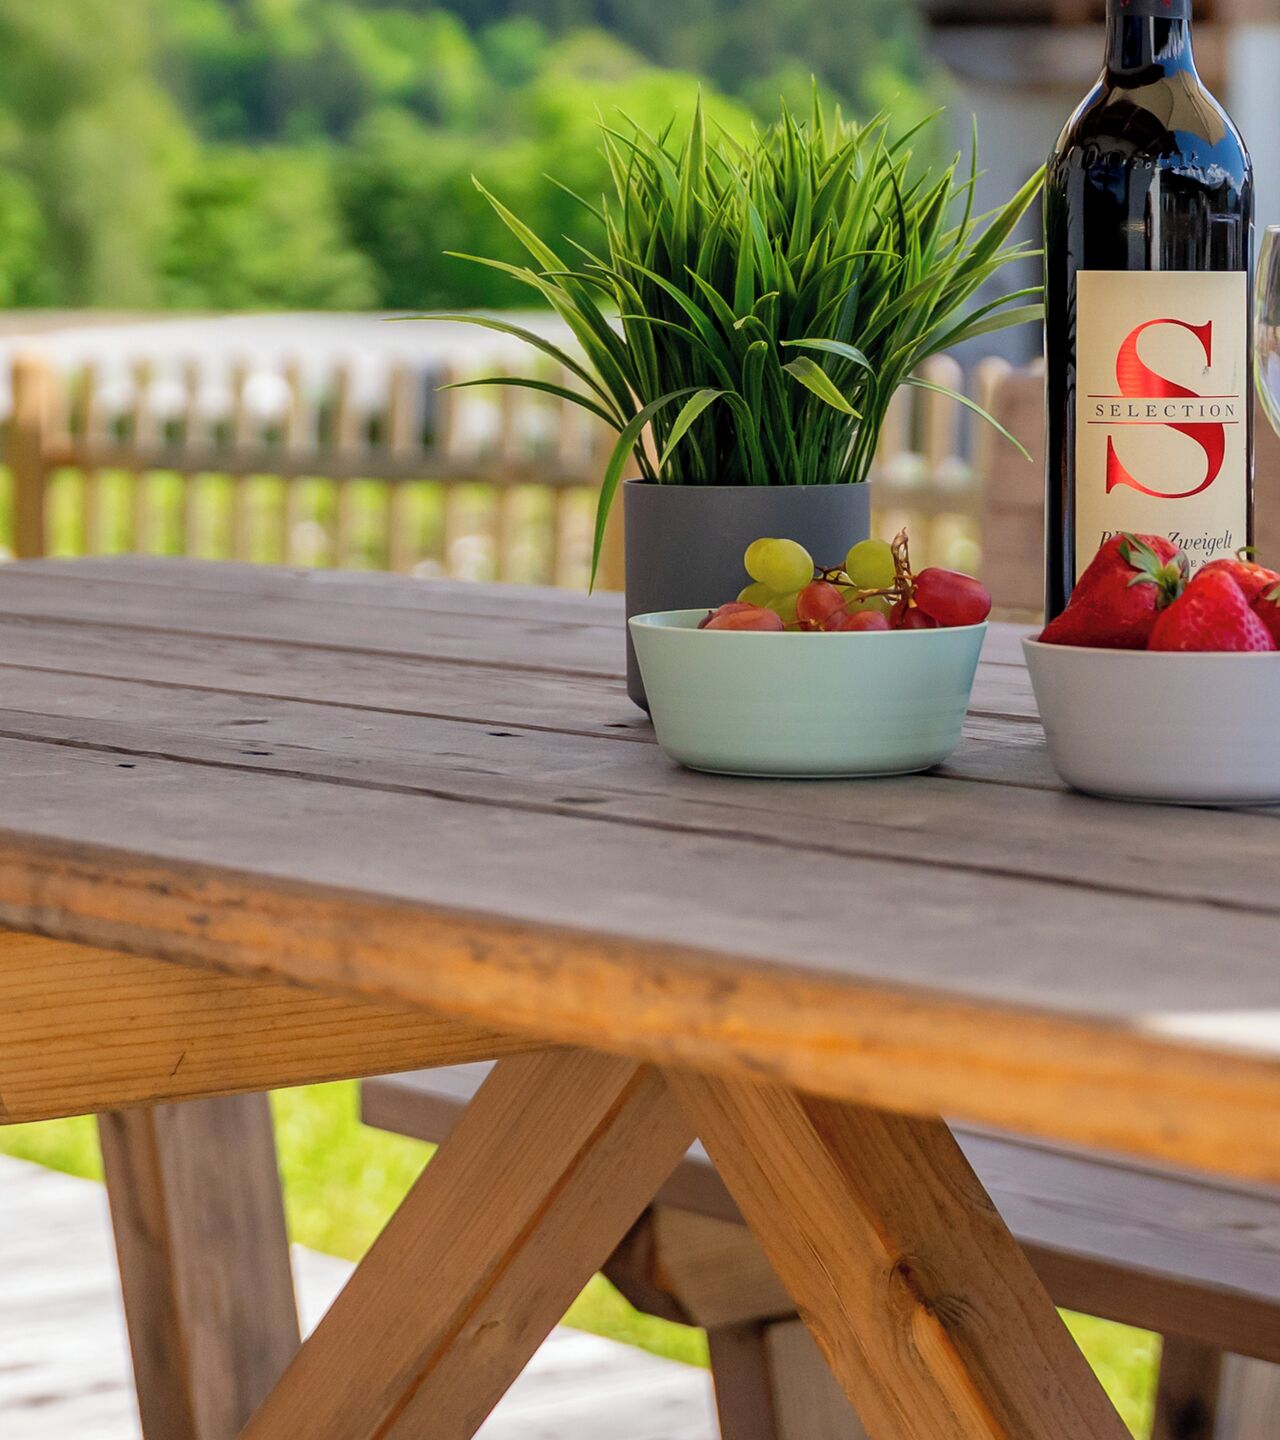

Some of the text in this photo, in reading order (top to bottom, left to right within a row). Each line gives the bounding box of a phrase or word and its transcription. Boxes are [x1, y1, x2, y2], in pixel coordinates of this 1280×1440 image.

[1095, 403, 1235, 418] SELECTION
[1106, 317, 1226, 499] S
[1167, 530, 1233, 557] Zweigelt
